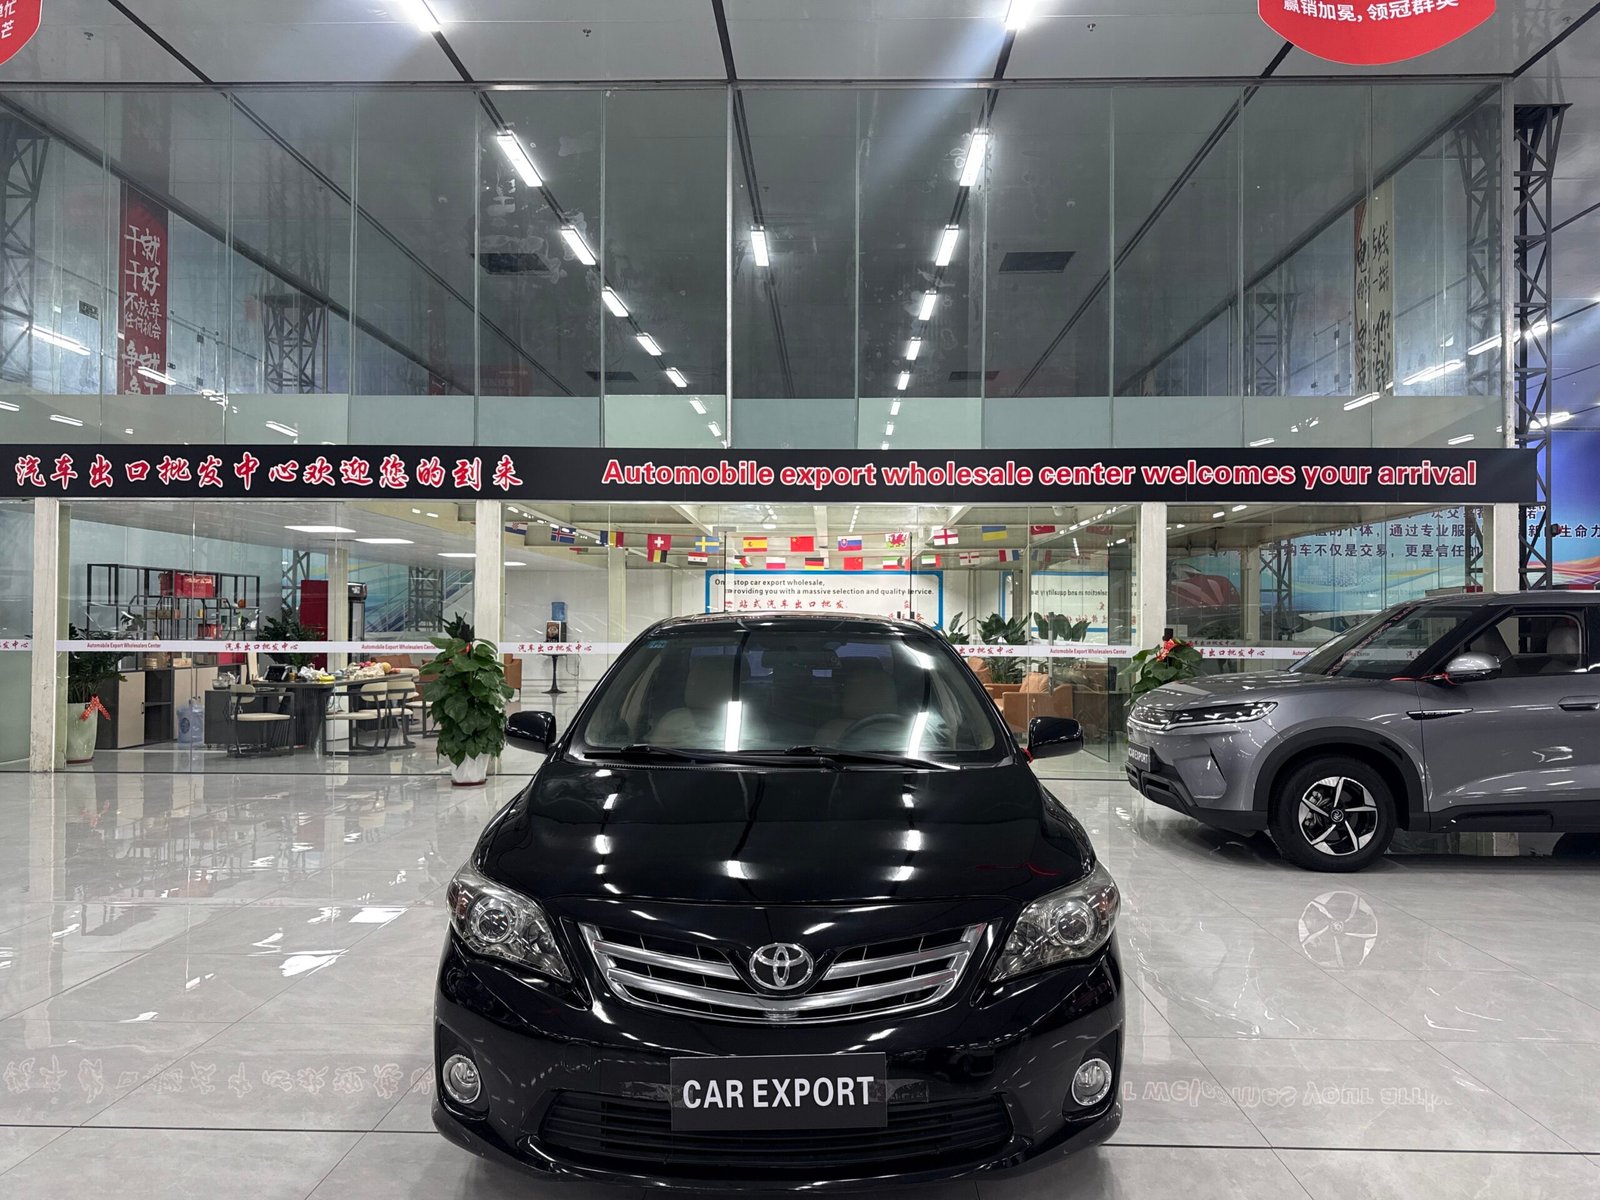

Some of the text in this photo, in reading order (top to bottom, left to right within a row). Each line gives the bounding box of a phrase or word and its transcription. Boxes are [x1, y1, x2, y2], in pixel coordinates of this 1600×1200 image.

[15, 453, 524, 491] 汽车出口批发中心欢迎您的到来
[602, 460, 1477, 490] Automobile export wholesale center welcomes your arrival
[762, 579, 786, 587] export
[880, 588, 906, 596] quality
[682, 1076, 875, 1108] CAR EXPORT
